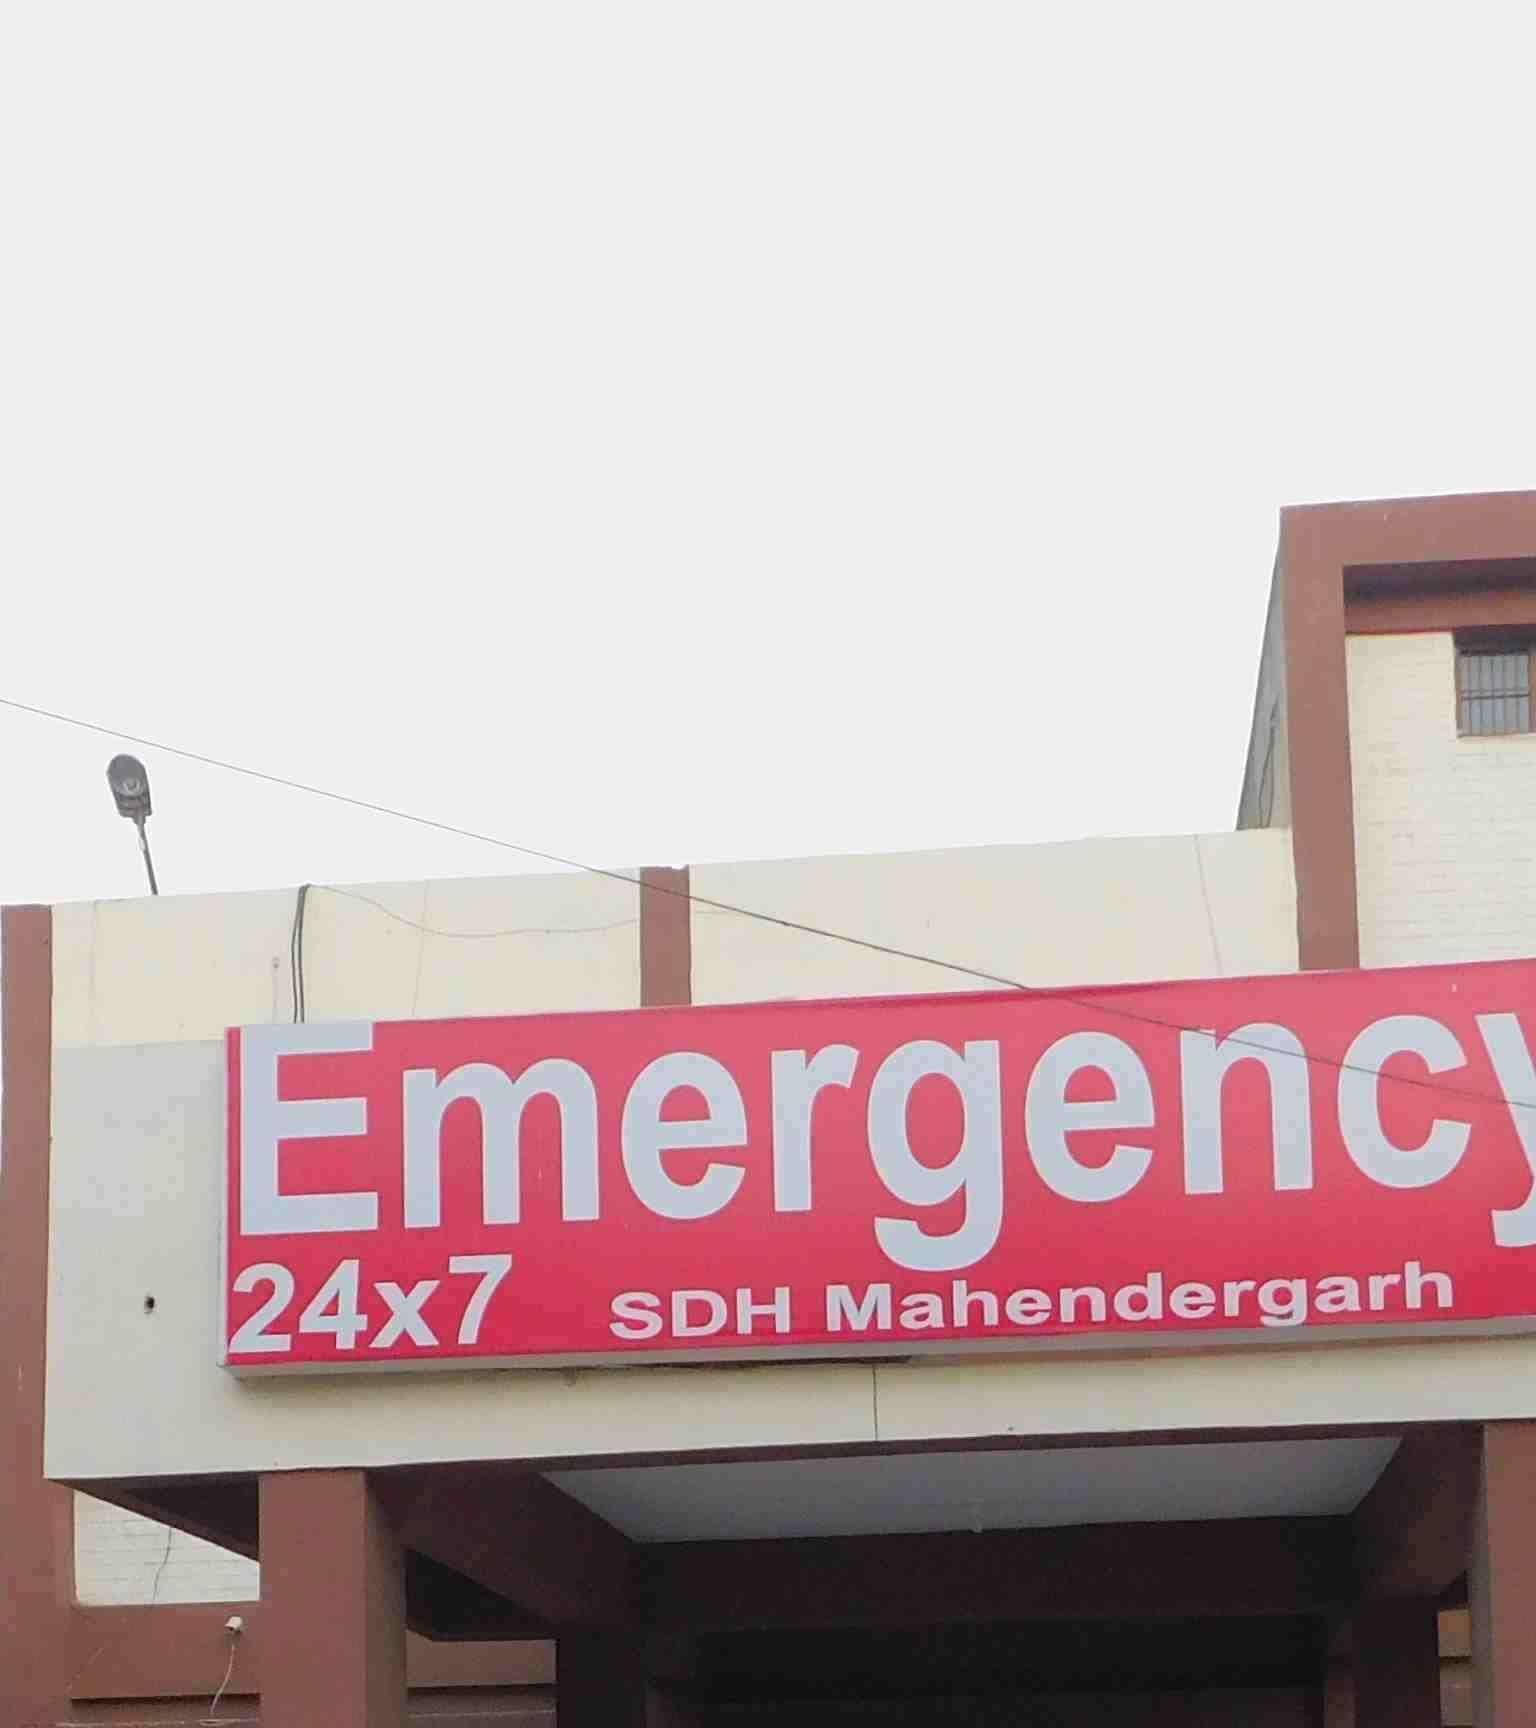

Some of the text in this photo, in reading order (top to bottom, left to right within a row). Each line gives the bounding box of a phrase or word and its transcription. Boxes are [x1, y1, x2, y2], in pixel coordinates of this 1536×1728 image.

[230, 1254, 512, 1354] 24x7
[611, 1262, 1454, 1339] SDH Mahendergarh
